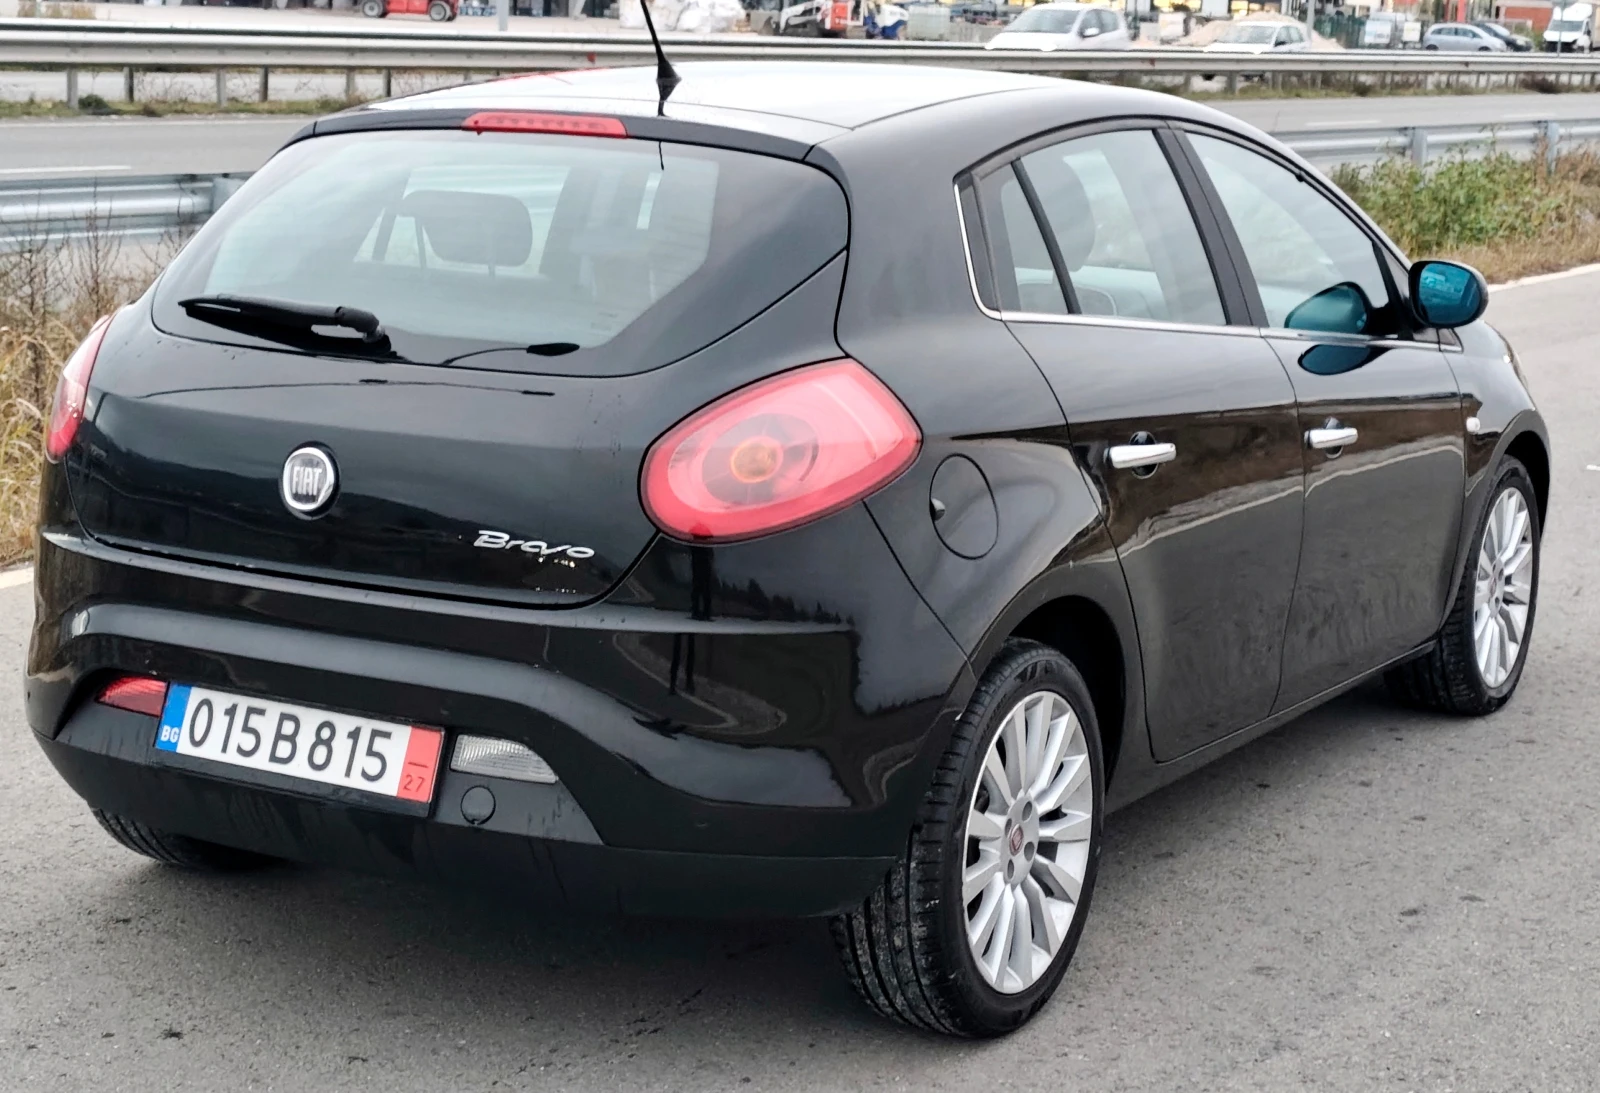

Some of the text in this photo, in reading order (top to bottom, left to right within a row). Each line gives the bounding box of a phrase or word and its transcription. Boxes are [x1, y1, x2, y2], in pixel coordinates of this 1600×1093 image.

[292, 466, 323, 496] FIAT
[473, 530, 595, 558] Bravo
[160, 725, 180, 743] BG
[403, 774, 426, 792] 27
